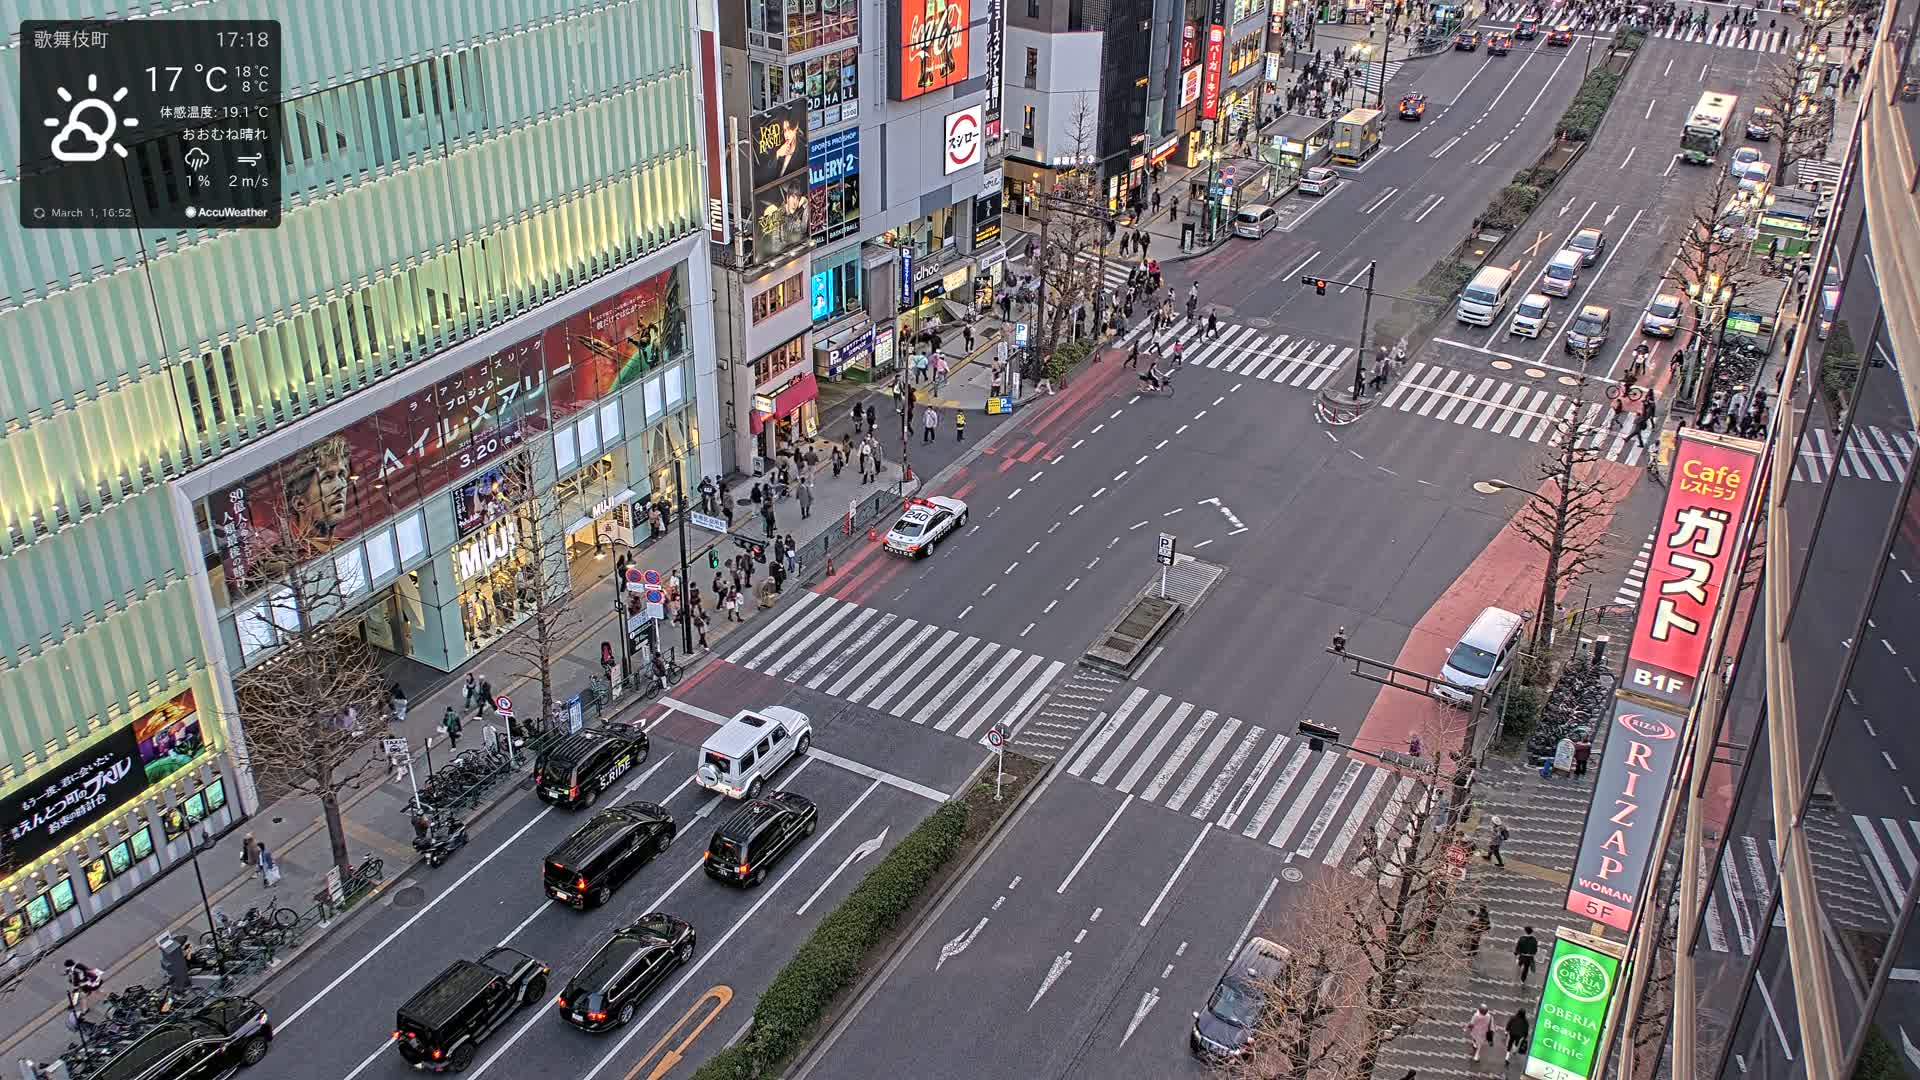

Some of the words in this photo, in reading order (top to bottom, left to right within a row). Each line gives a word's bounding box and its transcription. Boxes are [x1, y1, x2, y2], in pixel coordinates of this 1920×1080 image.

[1206, 44, 1219, 109] バーガーキング
[949, 132, 980, 149] スシロー
[710, 198, 723, 232] MUJI
[409, 340, 542, 412] ライアン・ゴズリング
[446, 376, 504, 411] プロジェクト
[459, 438, 499, 469] 3.20
[1682, 459, 1742, 489] Café
[1679, 476, 1737, 502] レストラン
[592, 496, 616, 520] MUJI
[904, 510, 929, 523] 240
[459, 518, 518, 582] MUJI
[884, 546, 914, 558] POLICE
[1649, 506, 1733, 642] ガスト
[1632, 667, 1685, 695] B1F
[1632, 719, 1664, 734] RIZAP
[18, 756, 132, 837] えんとつ町のプペル
[1597, 739, 1655, 881] RIZAP
[1578, 877, 1634, 904] WOMAN
[1584, 900, 1615, 920] 5F
[1559, 968, 1601, 990] OBERIA
[1543, 1002, 1598, 1031] OBERIA
[1543, 1019, 1592, 1046] Beauty
[1542, 1037, 1586, 1061] Clinic
